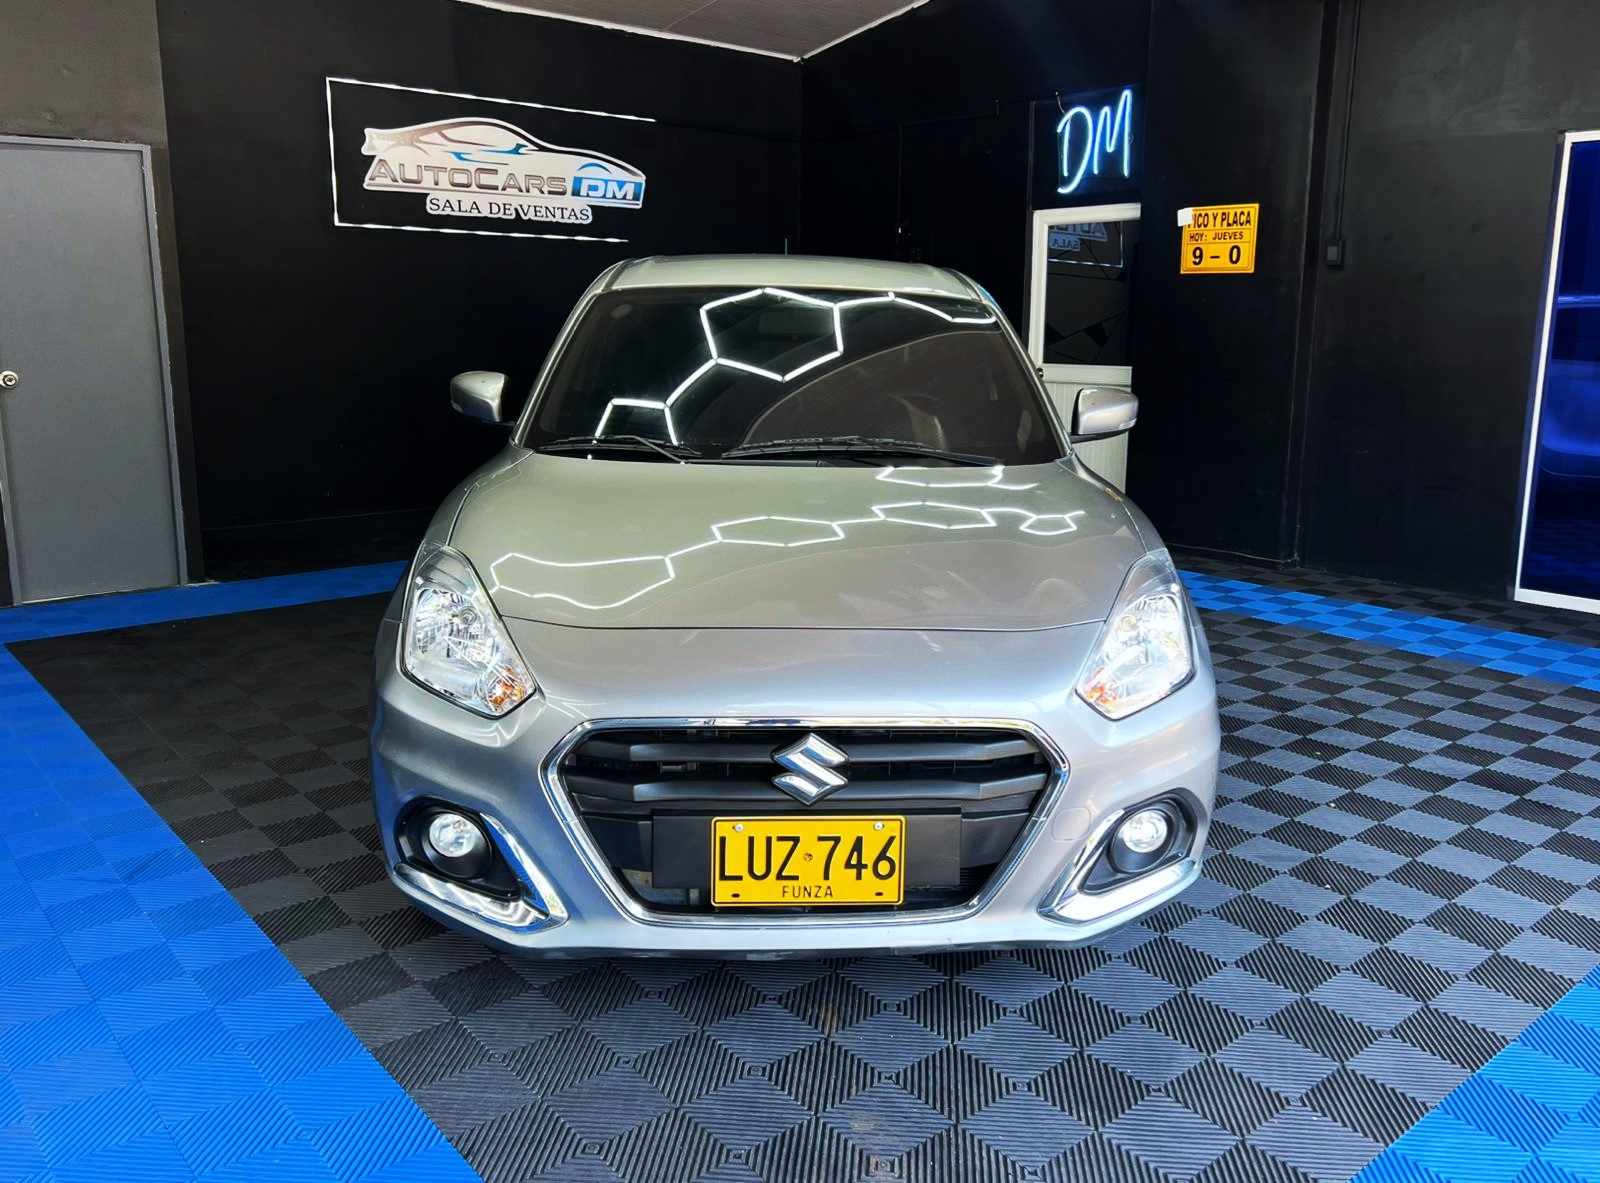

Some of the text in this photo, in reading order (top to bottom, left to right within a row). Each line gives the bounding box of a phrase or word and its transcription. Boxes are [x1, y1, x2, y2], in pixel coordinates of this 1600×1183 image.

[1057, 89, 1132, 193] DM
[580, 178, 635, 200] DM
[429, 198, 590, 221] SALA DE VENTAS
[1212, 212, 1218, 227] Y
[1220, 211, 1251, 228] PLACA
[1189, 231, 1244, 242] HOY: JUEVES
[1192, 246, 1203, 266] 9
[1229, 245, 1241, 265] 0
[719, 836, 896, 881] LUZ 746
[782, 885, 833, 898] FUNZA
